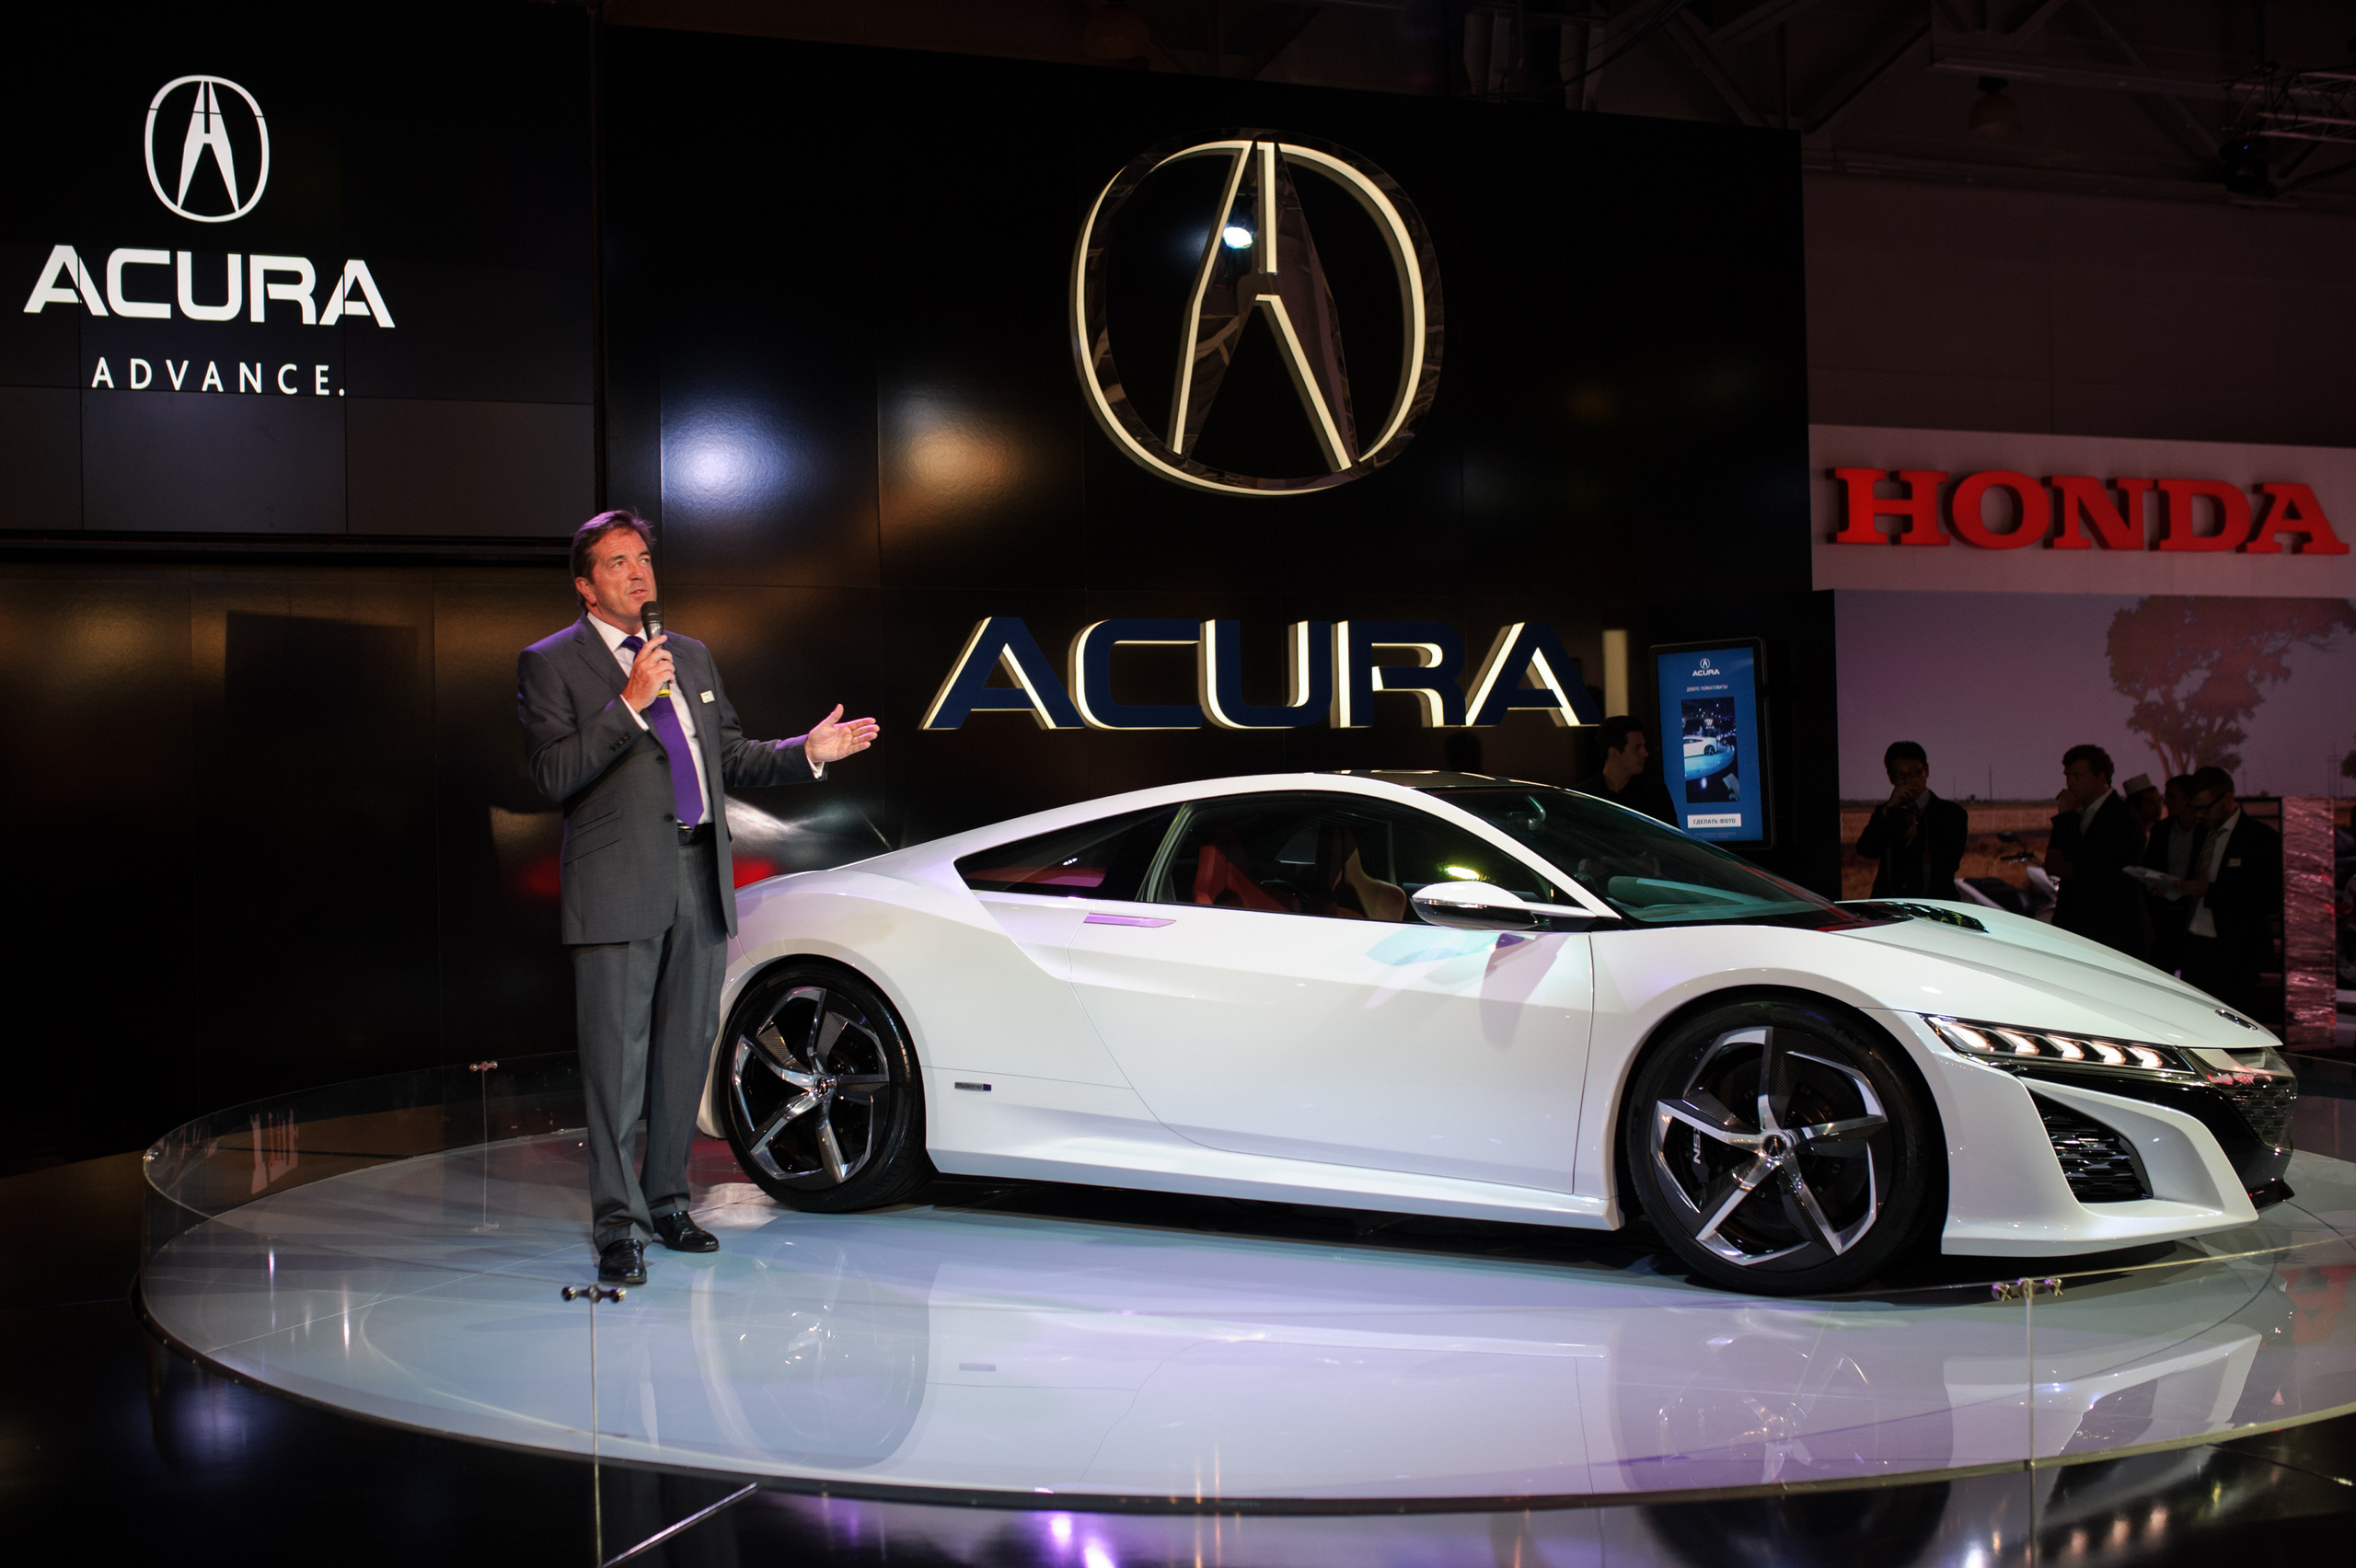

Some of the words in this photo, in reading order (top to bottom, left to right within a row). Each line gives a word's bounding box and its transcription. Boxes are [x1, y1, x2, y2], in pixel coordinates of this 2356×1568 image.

[23, 244, 396, 329] ACURA
[91, 356, 346, 397] ADVANCE.
[1826, 467, 2350, 556] HONDA
[918, 616, 1605, 731] ACURA
[1692, 669, 1720, 677] ACURA
